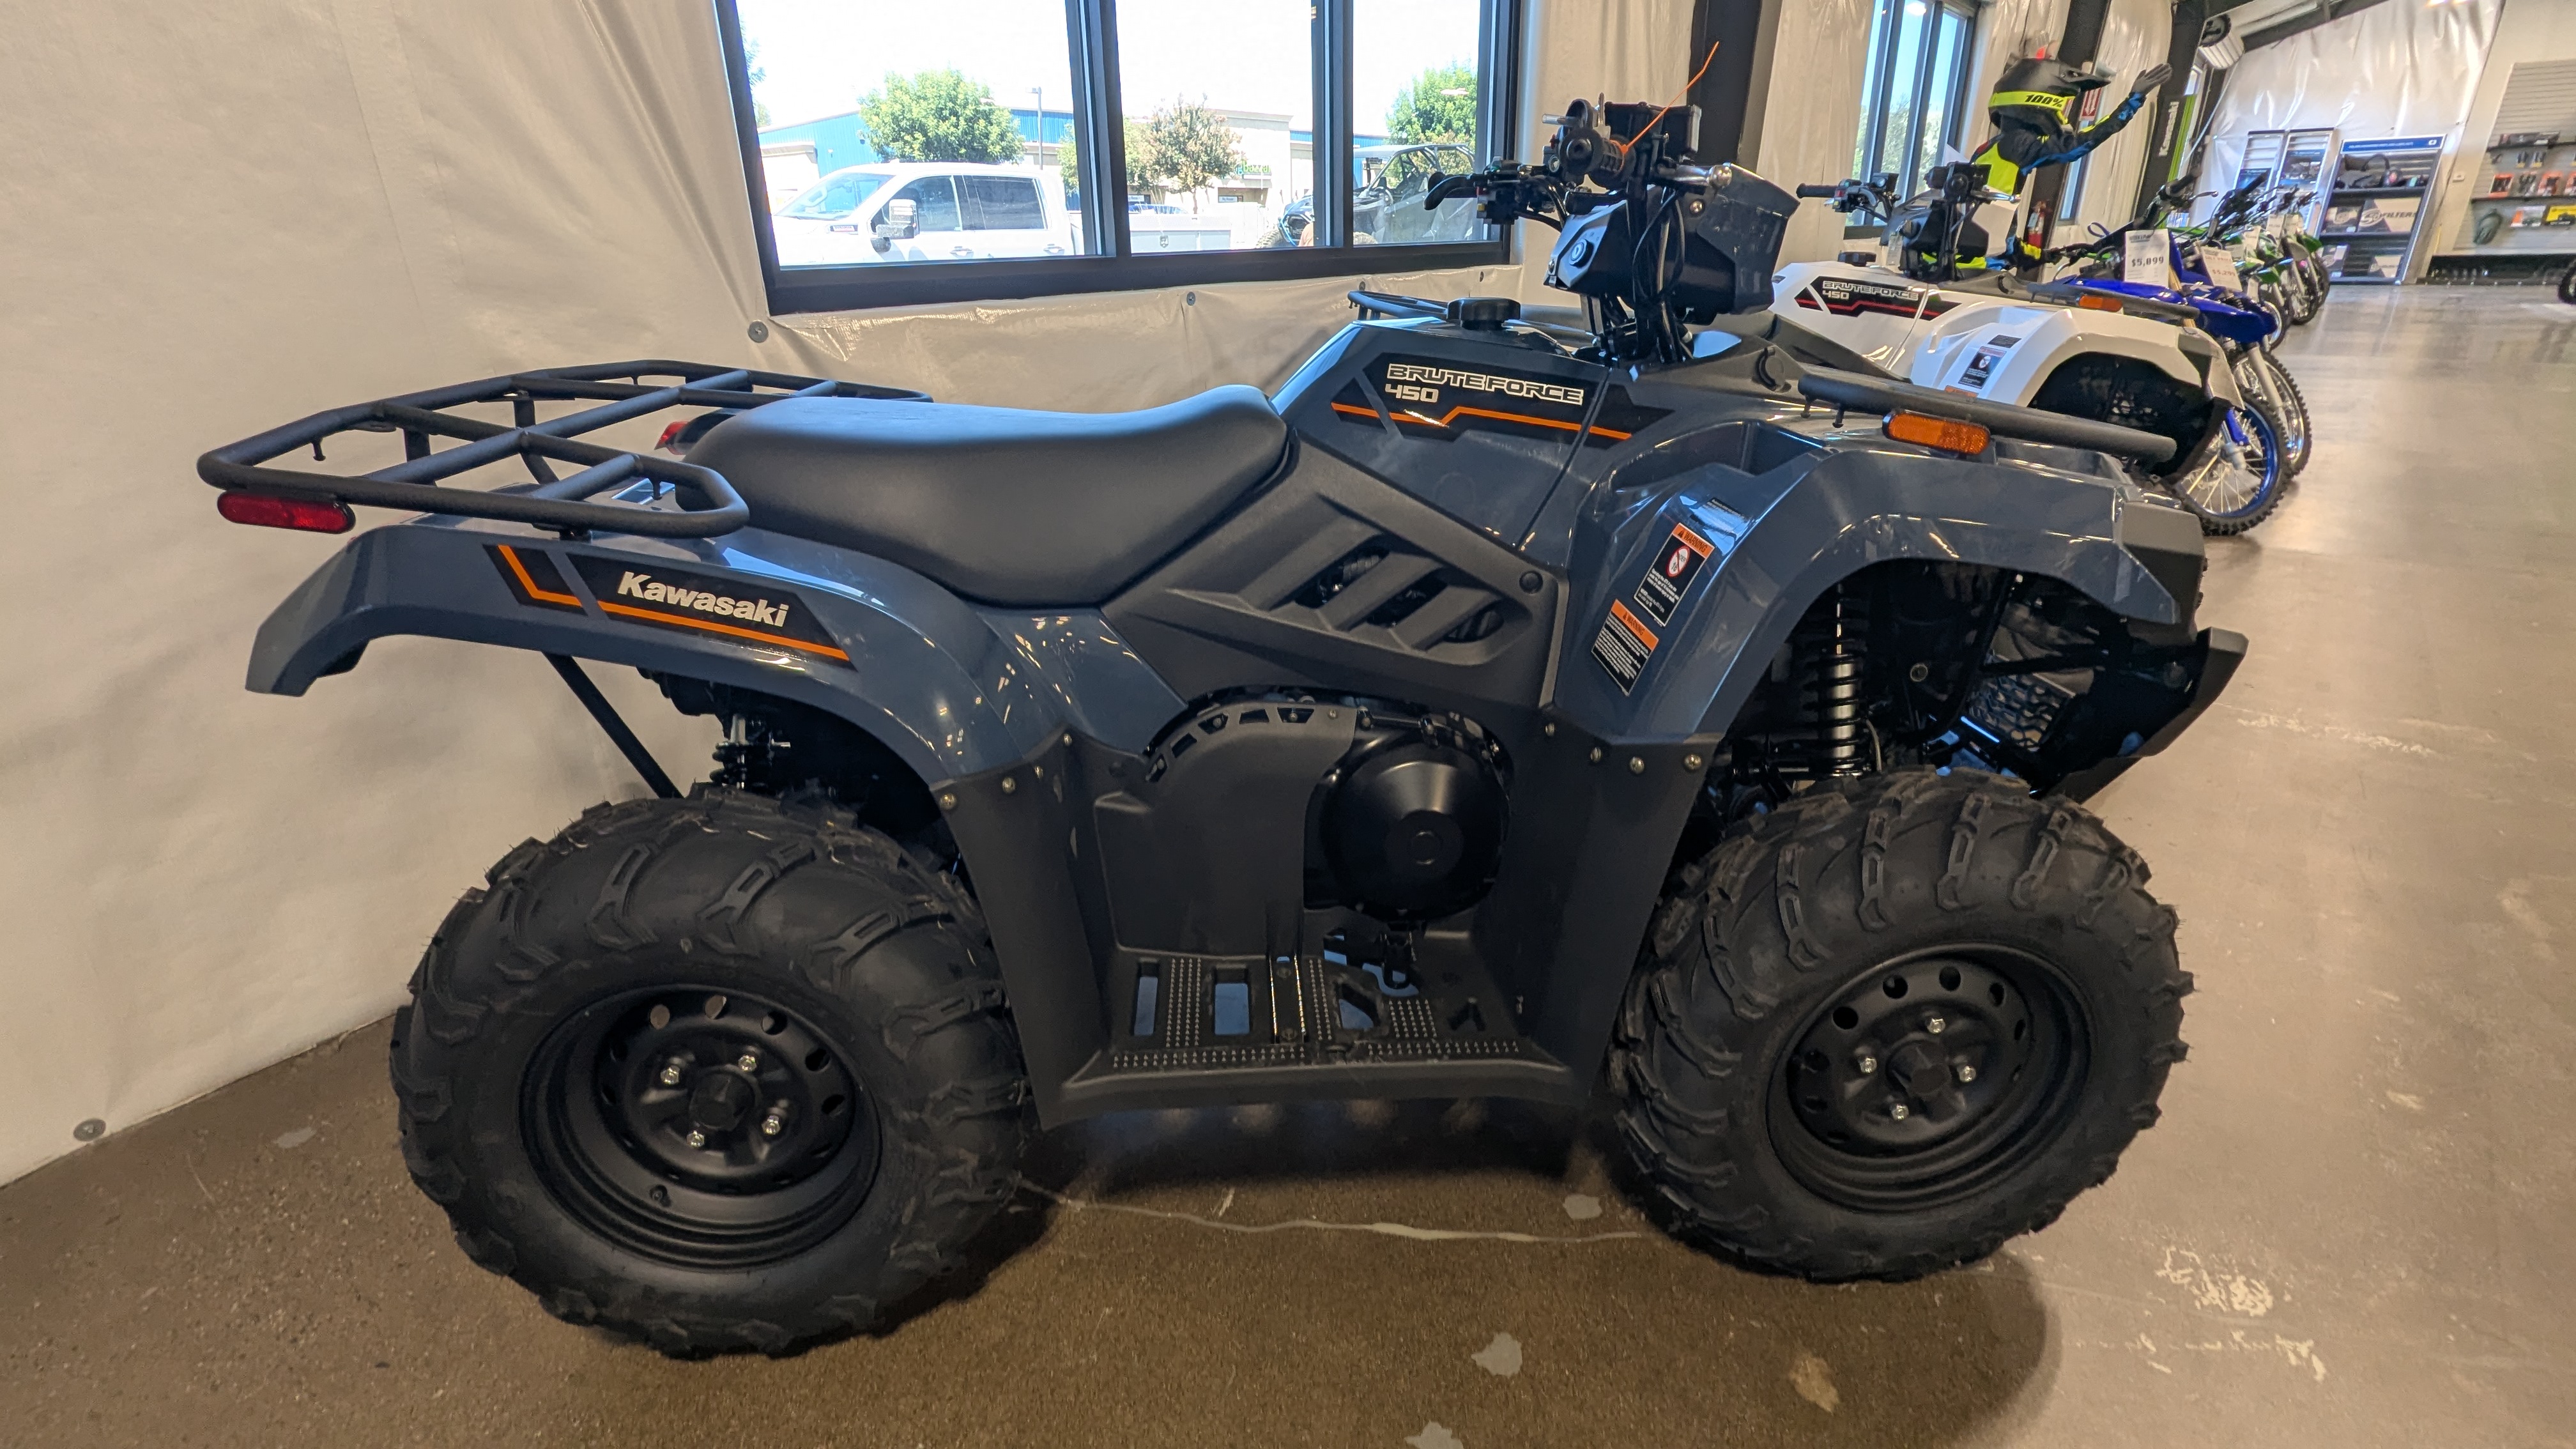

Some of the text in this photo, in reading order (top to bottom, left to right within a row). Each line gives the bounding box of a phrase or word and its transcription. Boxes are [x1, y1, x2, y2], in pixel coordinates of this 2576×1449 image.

[2025, 94, 2063, 107] 100%
[1822, 289, 1850, 300] 450
[1385, 383, 1439, 402] 450
[1683, 532, 1708, 553] WARNING
[618, 571, 789, 627] Kawasaki
